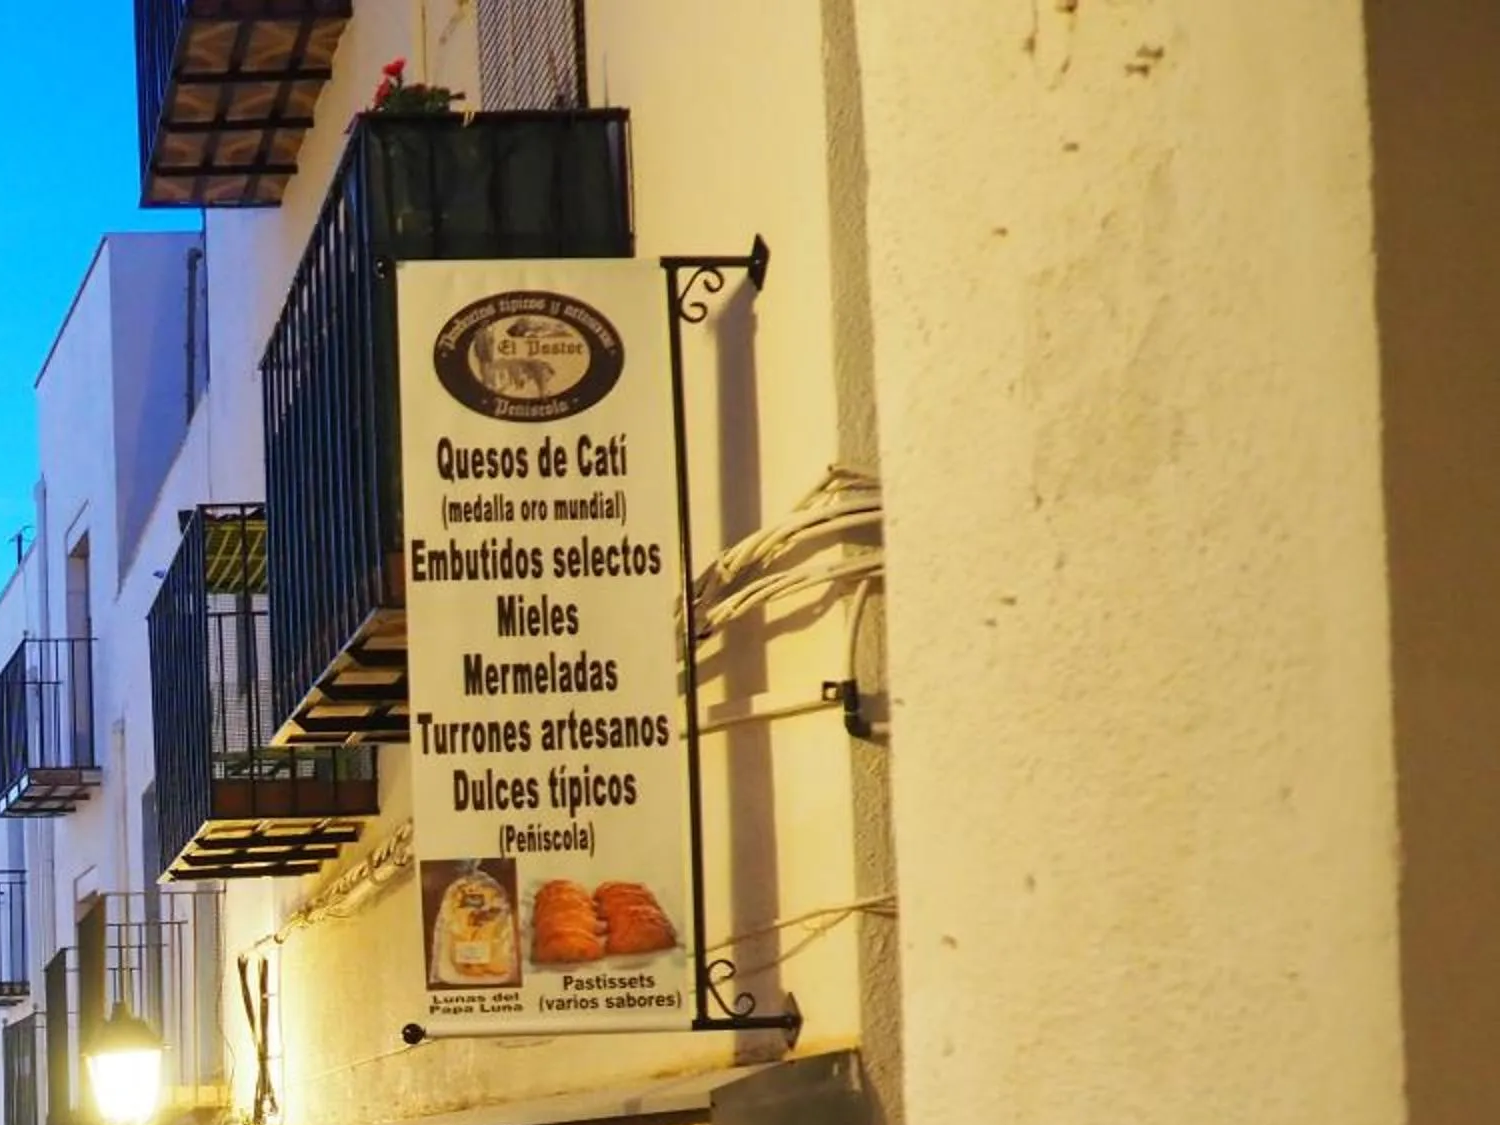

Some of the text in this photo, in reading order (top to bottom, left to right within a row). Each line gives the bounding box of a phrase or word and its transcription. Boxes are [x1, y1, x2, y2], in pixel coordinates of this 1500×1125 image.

[498, 338, 584, 356] El Pastor
[437, 433, 627, 483] Quesos de Catí
[441, 490, 627, 530] (medalla oro mundial)
[411, 535, 661, 582] Embutidos selectos
[497, 594, 579, 637] Mieles
[463, 650, 619, 696] Mermeladas
[417, 710, 670, 755] Turrones artesanos
[453, 764, 637, 819] Dulces típicos
[432, 992, 520, 1005] Lunas del
[539, 990, 682, 1013] (varios sabores)
[562, 973, 656, 991] Pastissets
[429, 1003, 525, 1015] Papa Luna
